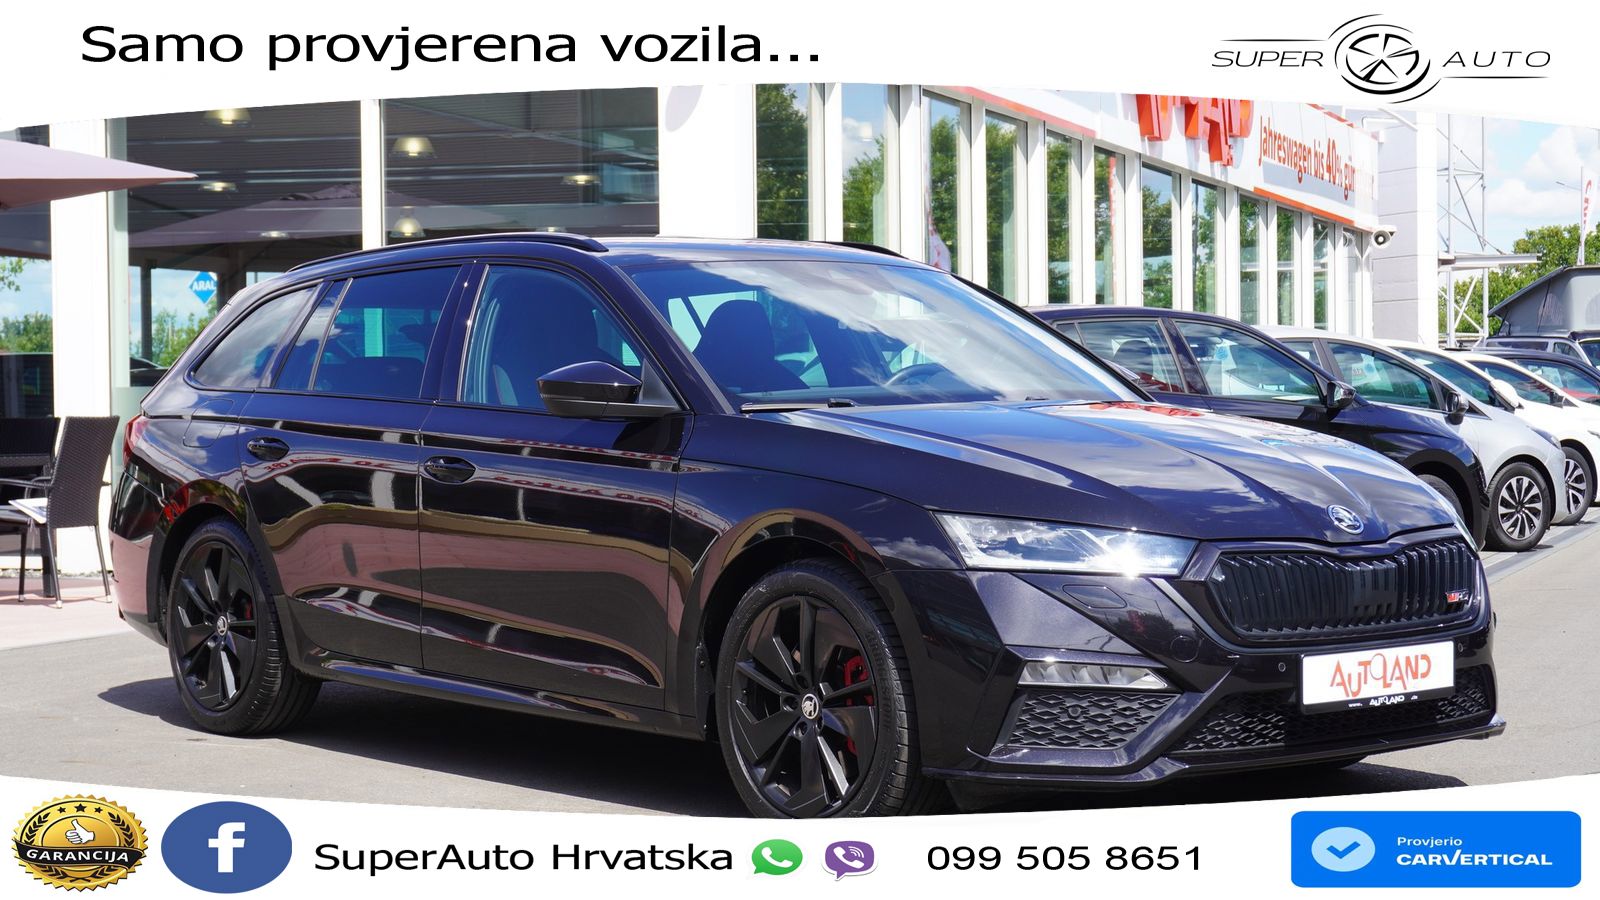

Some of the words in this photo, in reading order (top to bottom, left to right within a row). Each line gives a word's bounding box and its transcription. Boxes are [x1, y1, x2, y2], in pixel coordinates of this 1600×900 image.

[1258, 115, 1312, 184] Jahreswagen
[1313, 139, 1324, 181] bis
[1326, 137, 1342, 188] 40%
[191, 279, 217, 291] ARAL
[1330, 653, 1432, 698] AUTOLAND
[1369, 695, 1405, 707] AUTOLAND
